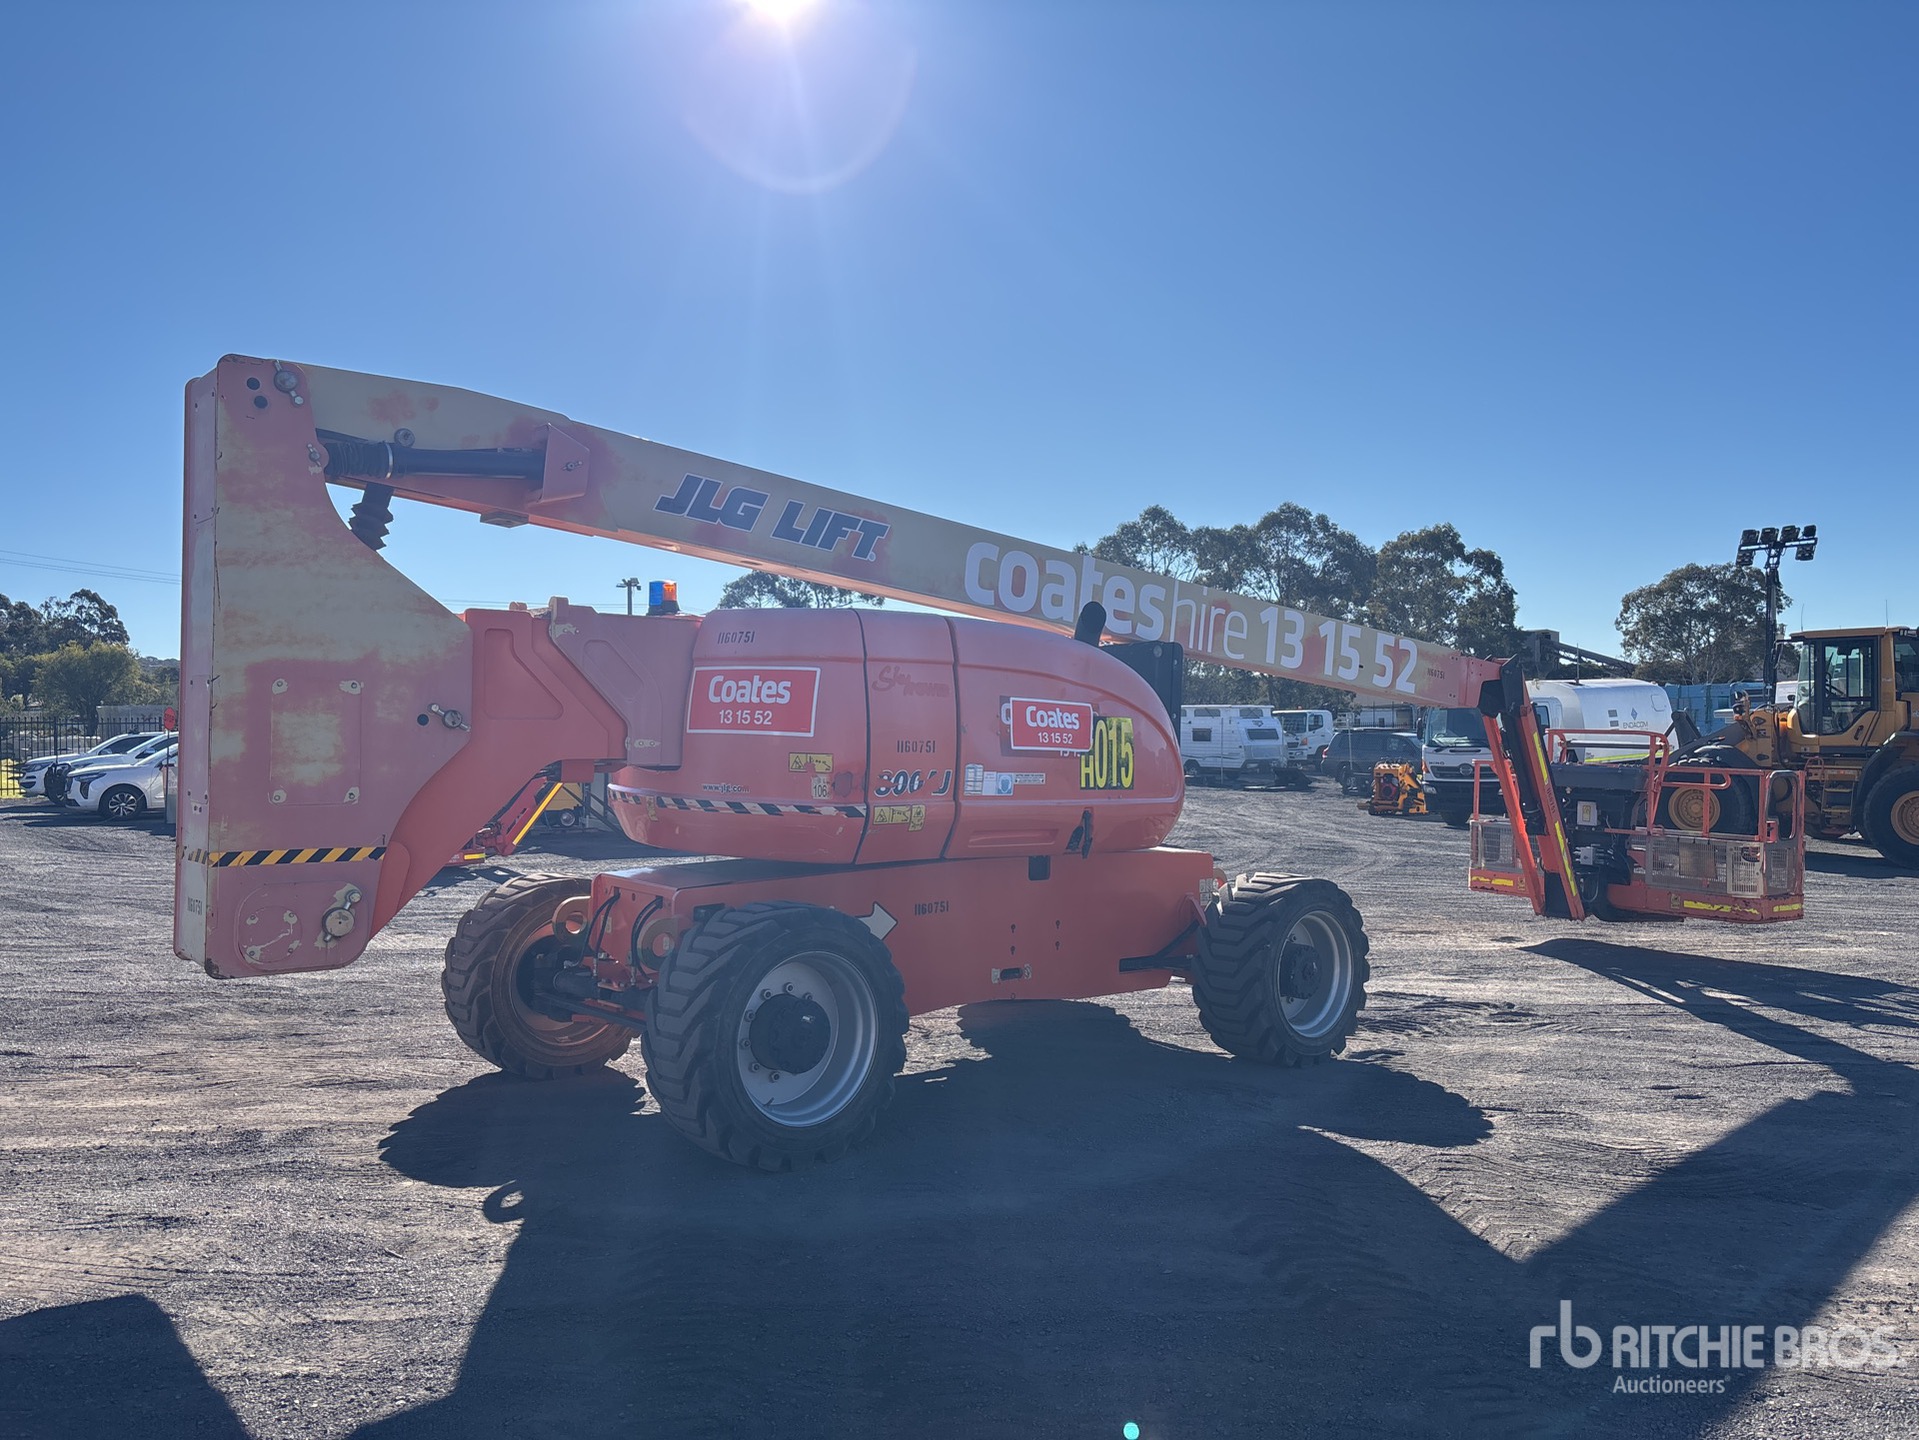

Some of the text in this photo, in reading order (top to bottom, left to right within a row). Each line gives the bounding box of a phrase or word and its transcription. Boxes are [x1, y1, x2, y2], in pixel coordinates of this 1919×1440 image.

[653, 473, 891, 562] JLG LIFT
[1259, 606, 1305, 669] 13
[1318, 620, 1362, 681] 15
[1372, 632, 1418, 694] 52
[708, 675, 792, 705] Coates
[719, 709, 773, 725] 13 15 52
[1025, 705, 1080, 730] Coates
[896, 740, 937, 753] 1160751
[1038, 732, 1073, 744] 13 15 52
[914, 900, 950, 916] 1160751
